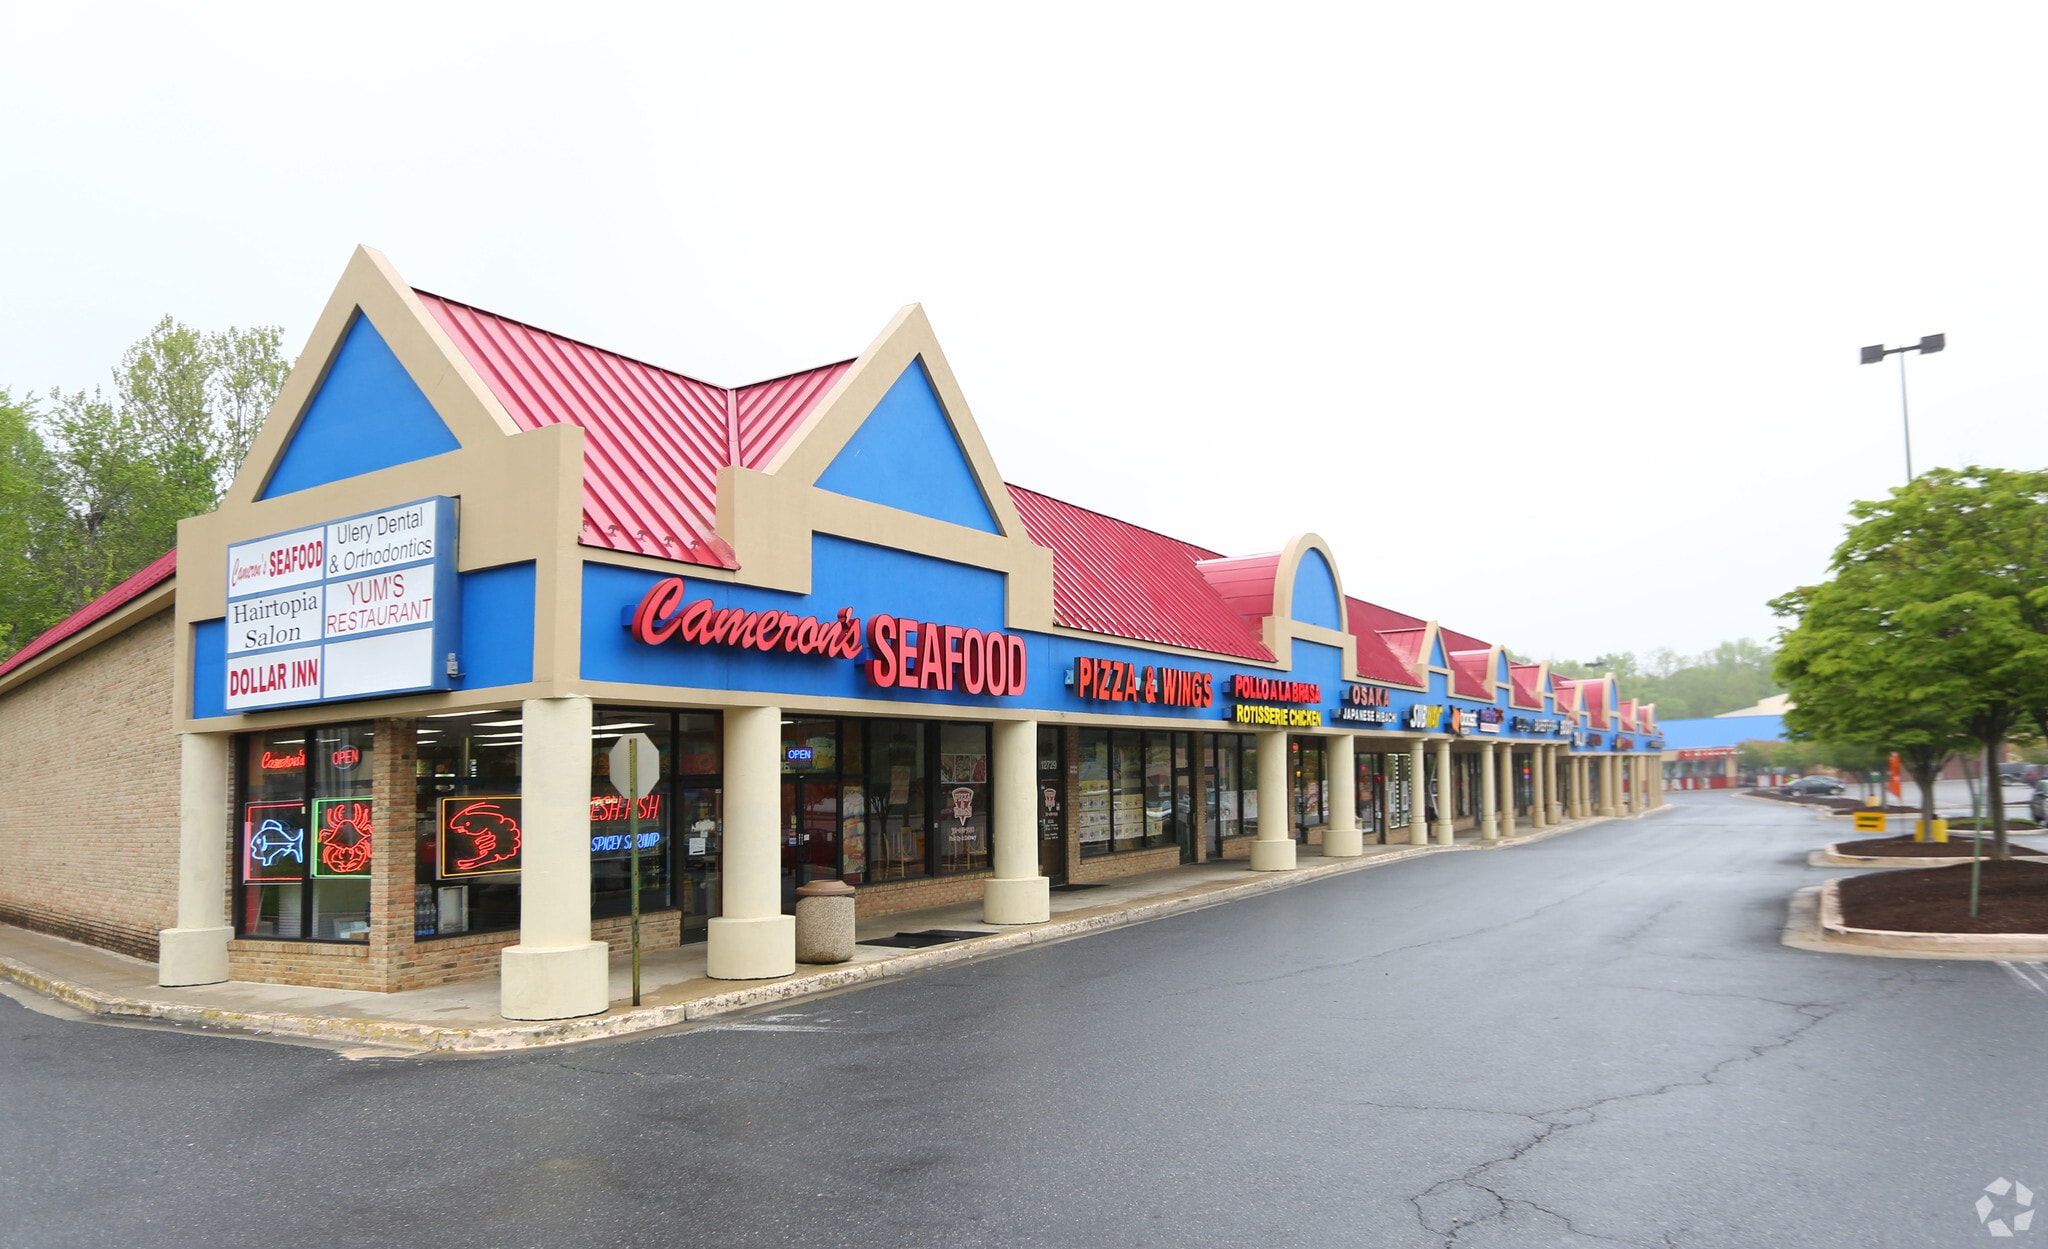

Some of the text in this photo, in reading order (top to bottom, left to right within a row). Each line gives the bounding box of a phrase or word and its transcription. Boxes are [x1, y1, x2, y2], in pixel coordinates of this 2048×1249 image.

[337, 506, 423, 545] Ulery Dental
[231, 540, 323, 587] Cameron's SEAFOOD
[329, 538, 432, 573] & Orthodontics
[347, 573, 405, 605] YUM'S
[233, 591, 318, 624] Hairtopia
[326, 598, 432, 634] RESTAURANT
[244, 625, 301, 649] Salon
[632, 577, 1028, 696] Cameron's SEAFOOD
[230, 658, 318, 697] DOLLAR INN
[1075, 656, 1213, 708] PIZZA & WINGS
[1234, 674, 1322, 704] POLLO A LA BRASA
[1352, 684, 1390, 706] OSAKA
[1236, 704, 1322, 727] ROTISSERIE CHICKEN
[1342, 708, 1375, 722] JAPANESE
[332, 749, 359, 766] OPEN
[788, 749, 812, 759] OPEN
[624, 794, 660, 819] FSH
[591, 832, 660, 852] SPICEY SRIMP
